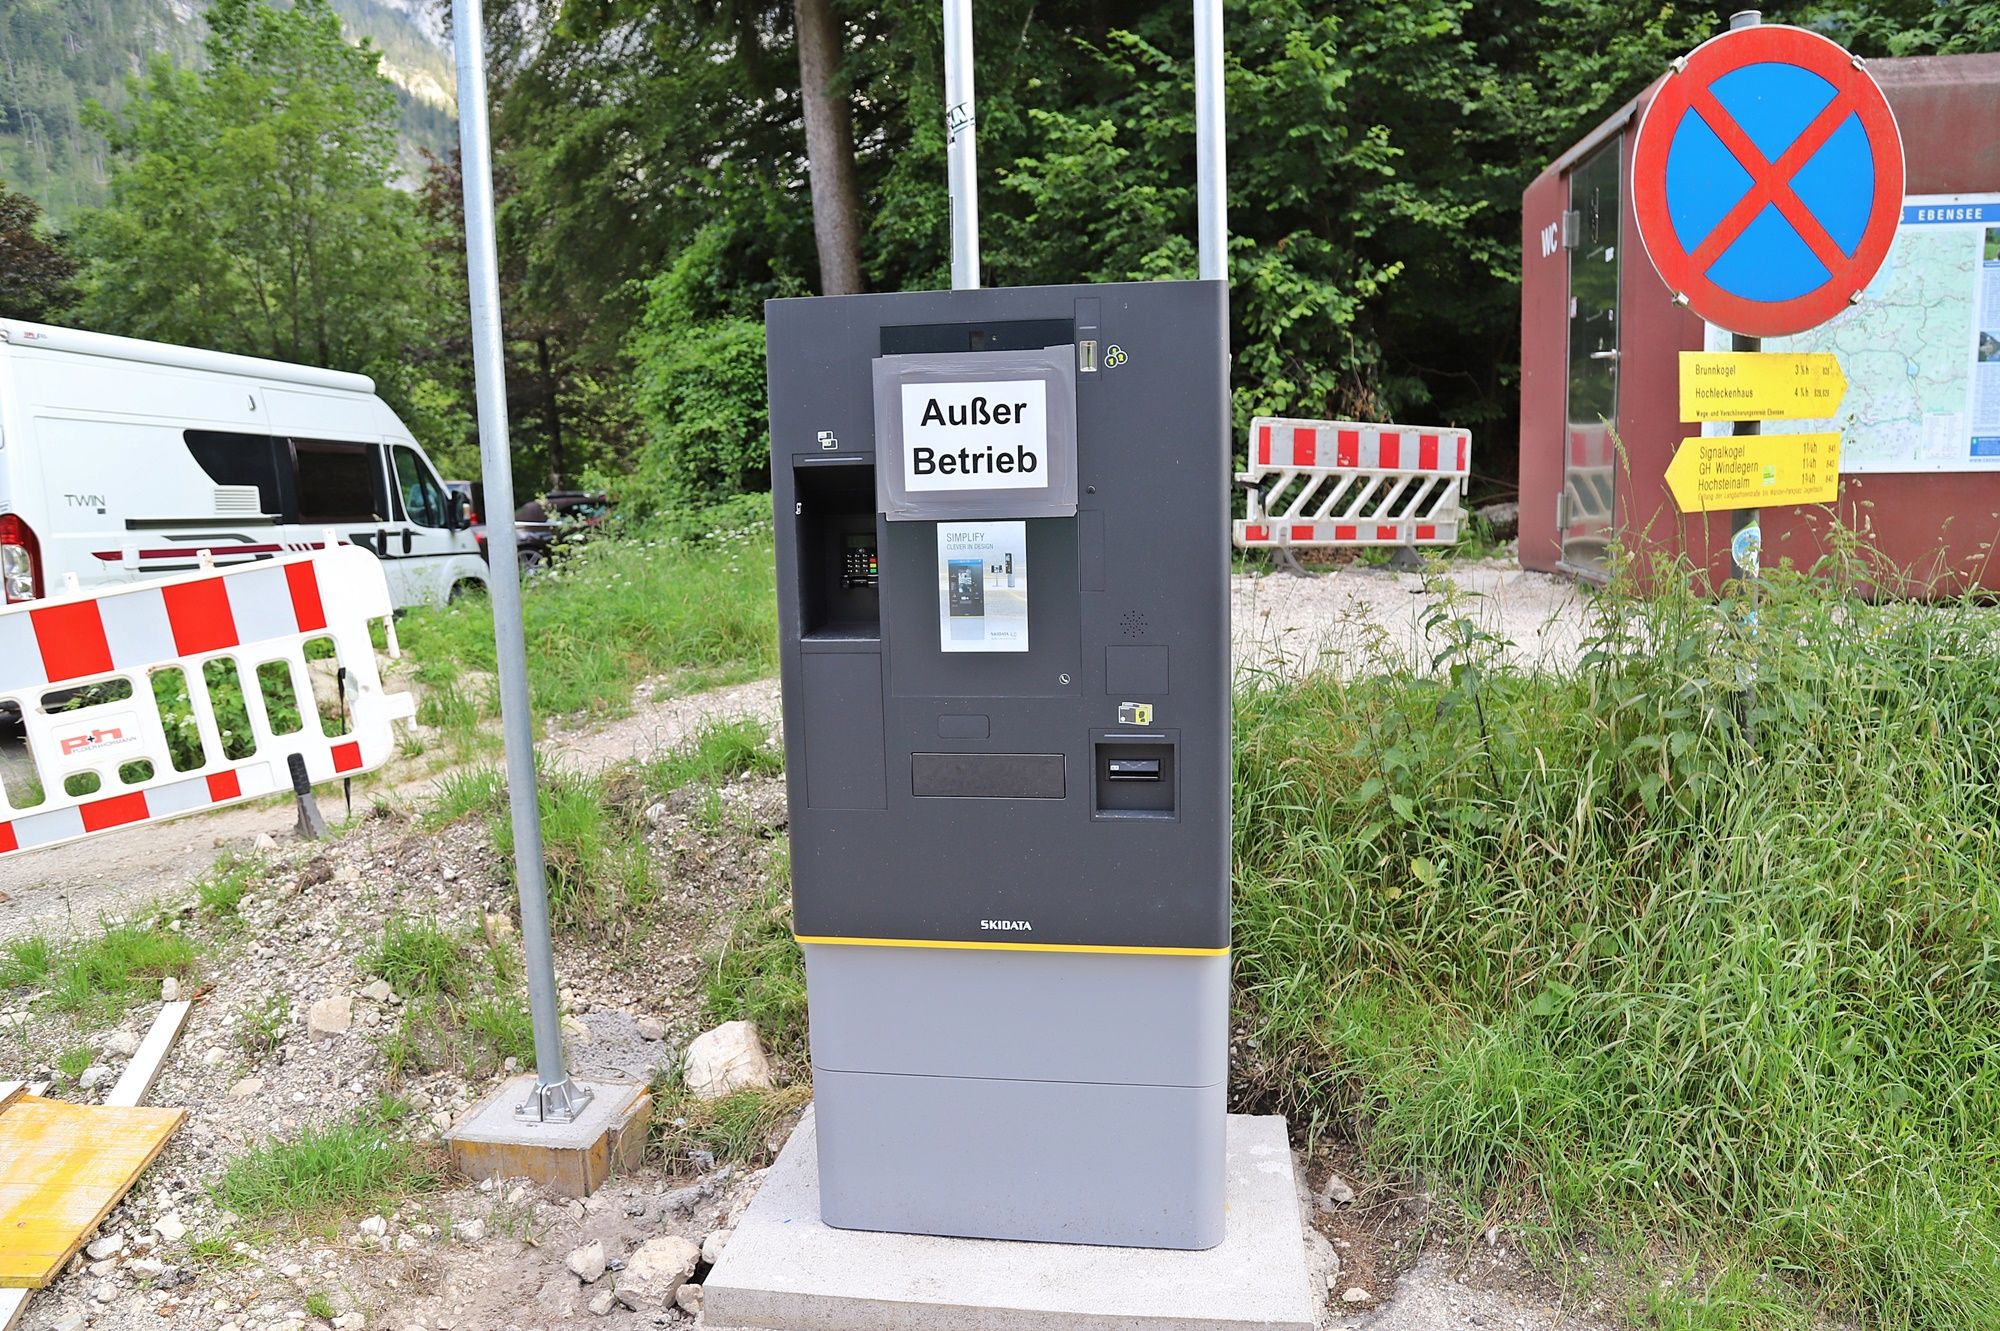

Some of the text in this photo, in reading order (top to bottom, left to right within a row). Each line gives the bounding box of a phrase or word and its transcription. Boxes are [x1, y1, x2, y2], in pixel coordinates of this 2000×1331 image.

[1918, 208, 1983, 221] EBENSEE
[1541, 222, 1558, 258] WC
[1695, 364, 1736, 377] Brunnkogel
[1695, 387, 1754, 398] Hochleckenhaus
[920, 396, 1027, 426] Außer
[1699, 444, 1745, 461] Signalkogel
[913, 445, 1037, 475] Betrieb
[1699, 462, 1711, 475] GH
[1715, 461, 1759, 475] Windlegern
[1698, 477, 1750, 491] Hochsteinalm
[64, 494, 105, 506] TWIN
[946, 532, 985, 542] SIMPLIFY
[946, 543, 966, 551] CLEVER
[981, 920, 1032, 930] SKIDATA
